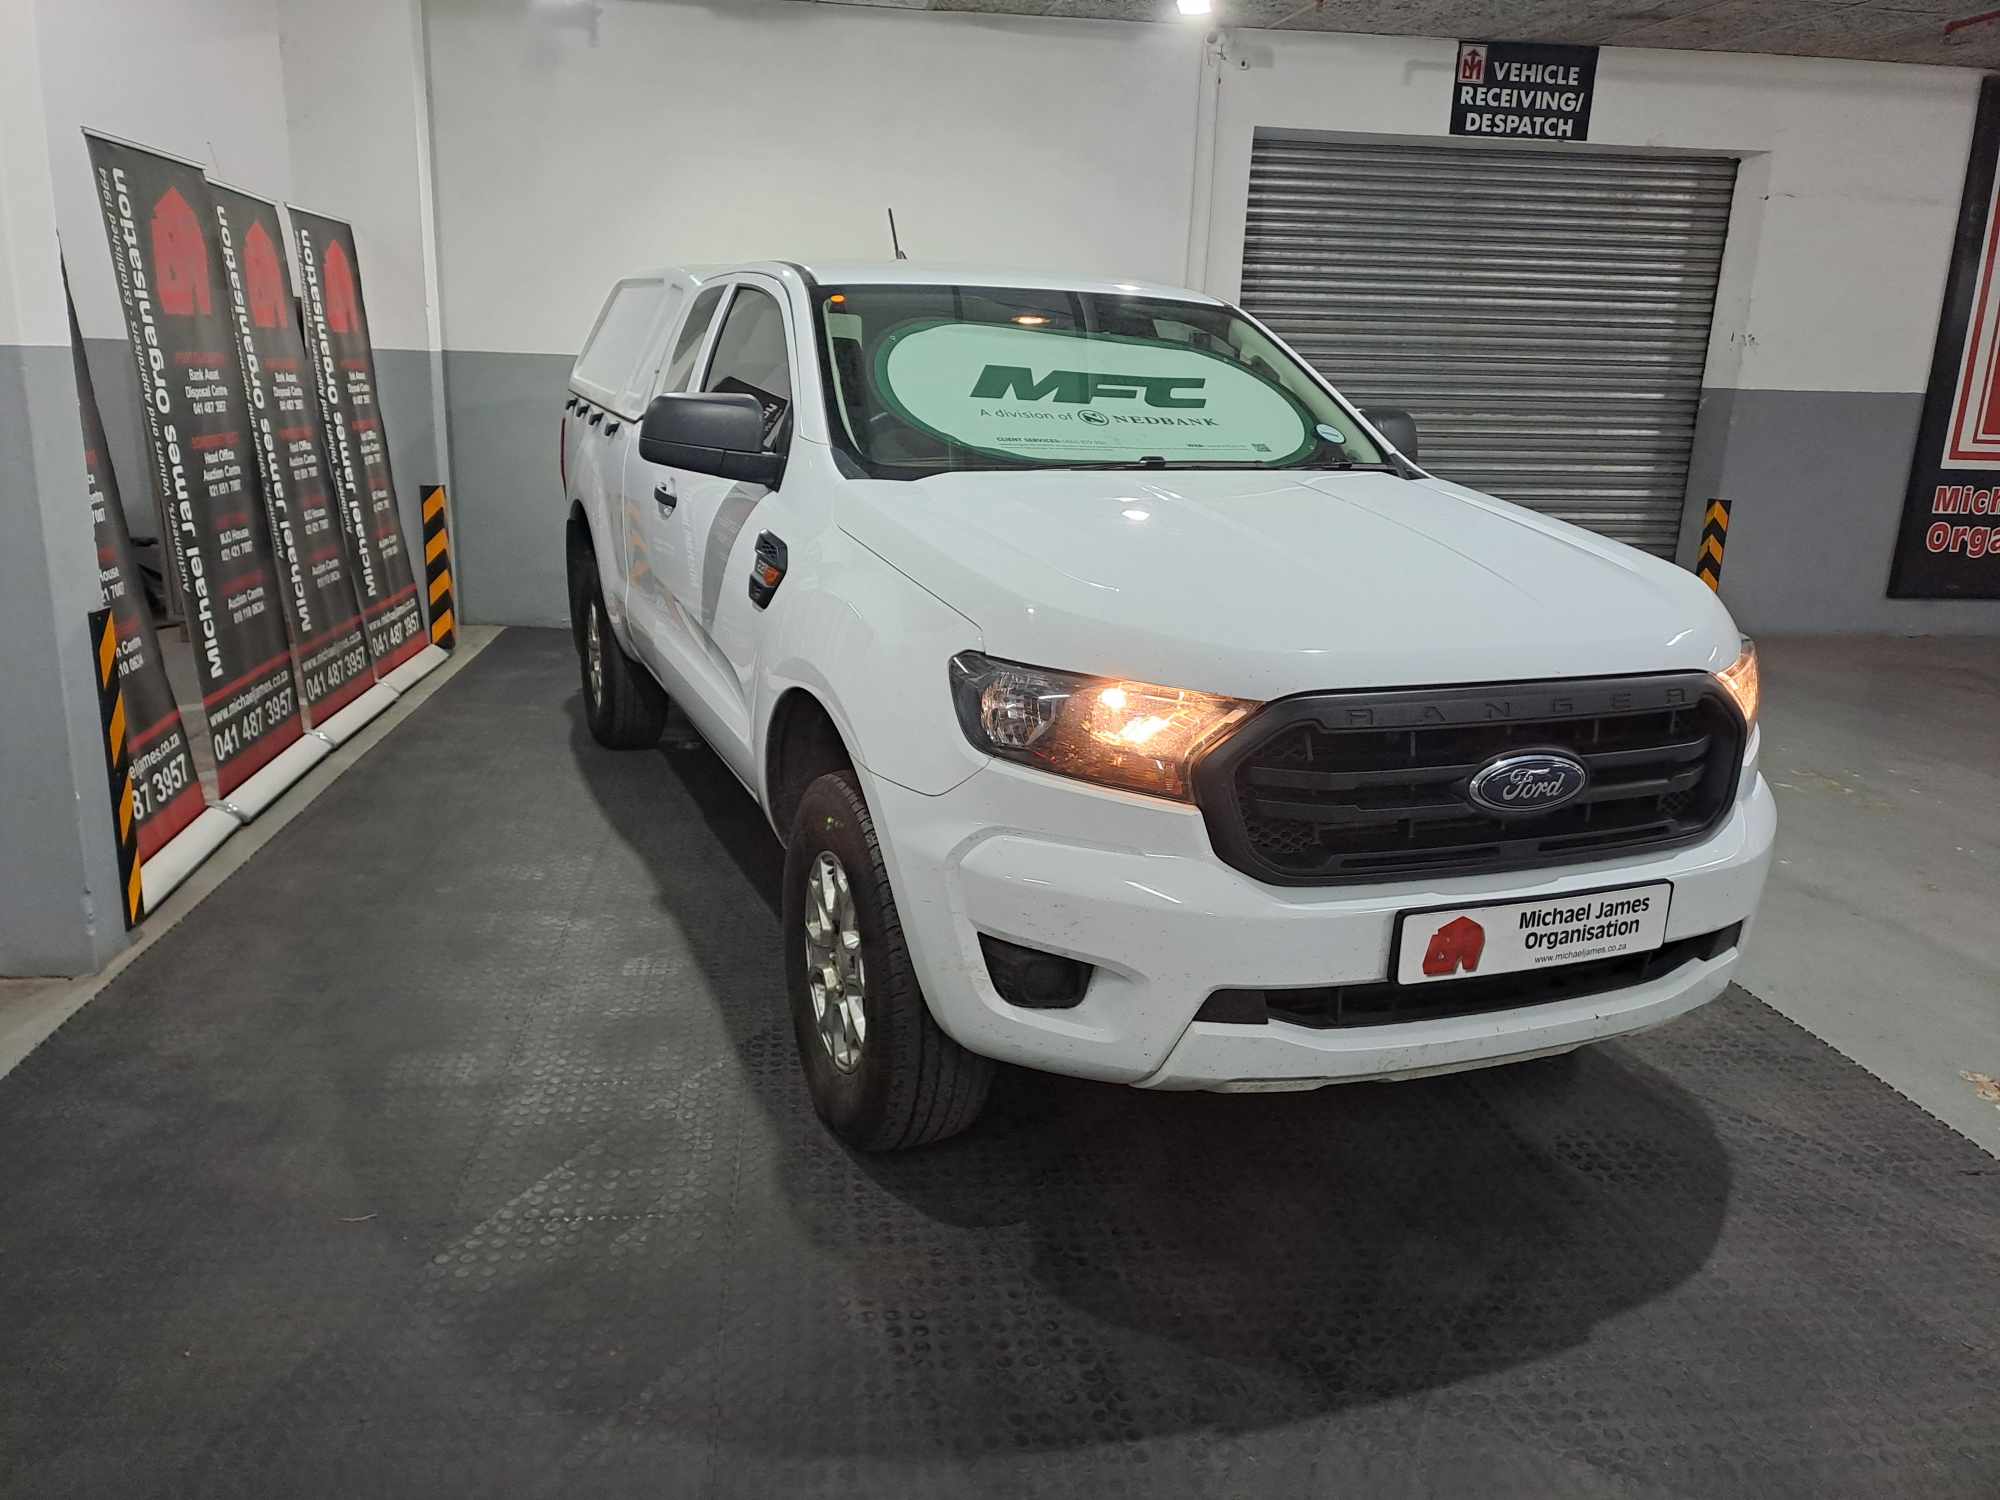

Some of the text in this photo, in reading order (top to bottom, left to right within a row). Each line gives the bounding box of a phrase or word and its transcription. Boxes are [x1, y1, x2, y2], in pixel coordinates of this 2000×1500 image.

[1493, 62, 1580, 86] VEHICLE
[1460, 86, 1585, 112] RECEIVING/
[1465, 112, 1574, 137] DESPATCH
[106, 212, 134, 306] Established
[216, 205, 265, 409] Organisation
[301, 228, 339, 405] Organisation
[130, 320, 153, 404] Appraisers
[969, 364, 1207, 409] MFC
[112, 167, 224, 680] Michael James Organisation
[146, 406, 159, 437] and
[980, 408, 1074, 421] A division of
[1112, 415, 1220, 427] NEDBANK
[154, 441, 171, 497] Valuers
[260, 418, 287, 513] James
[333, 411, 357, 494] James
[348, 500, 377, 597] Michael
[280, 520, 312, 633] Michael
[372, 631, 389, 657] 041
[306, 646, 366, 701] 041 487 3957
[214, 687, 292, 761] 041 487 3957
[1345, 688, 1688, 726] RANGER
[128, 733, 180, 779] eljames.co.za
[132, 753, 188, 820] 87 3957
[1502, 767, 1566, 801] Ford
[1519, 897, 1650, 930] Michael James
[1525, 918, 1640, 950] Organisation
[1534, 943, 1627, 964] www.michaeljames.co.za
